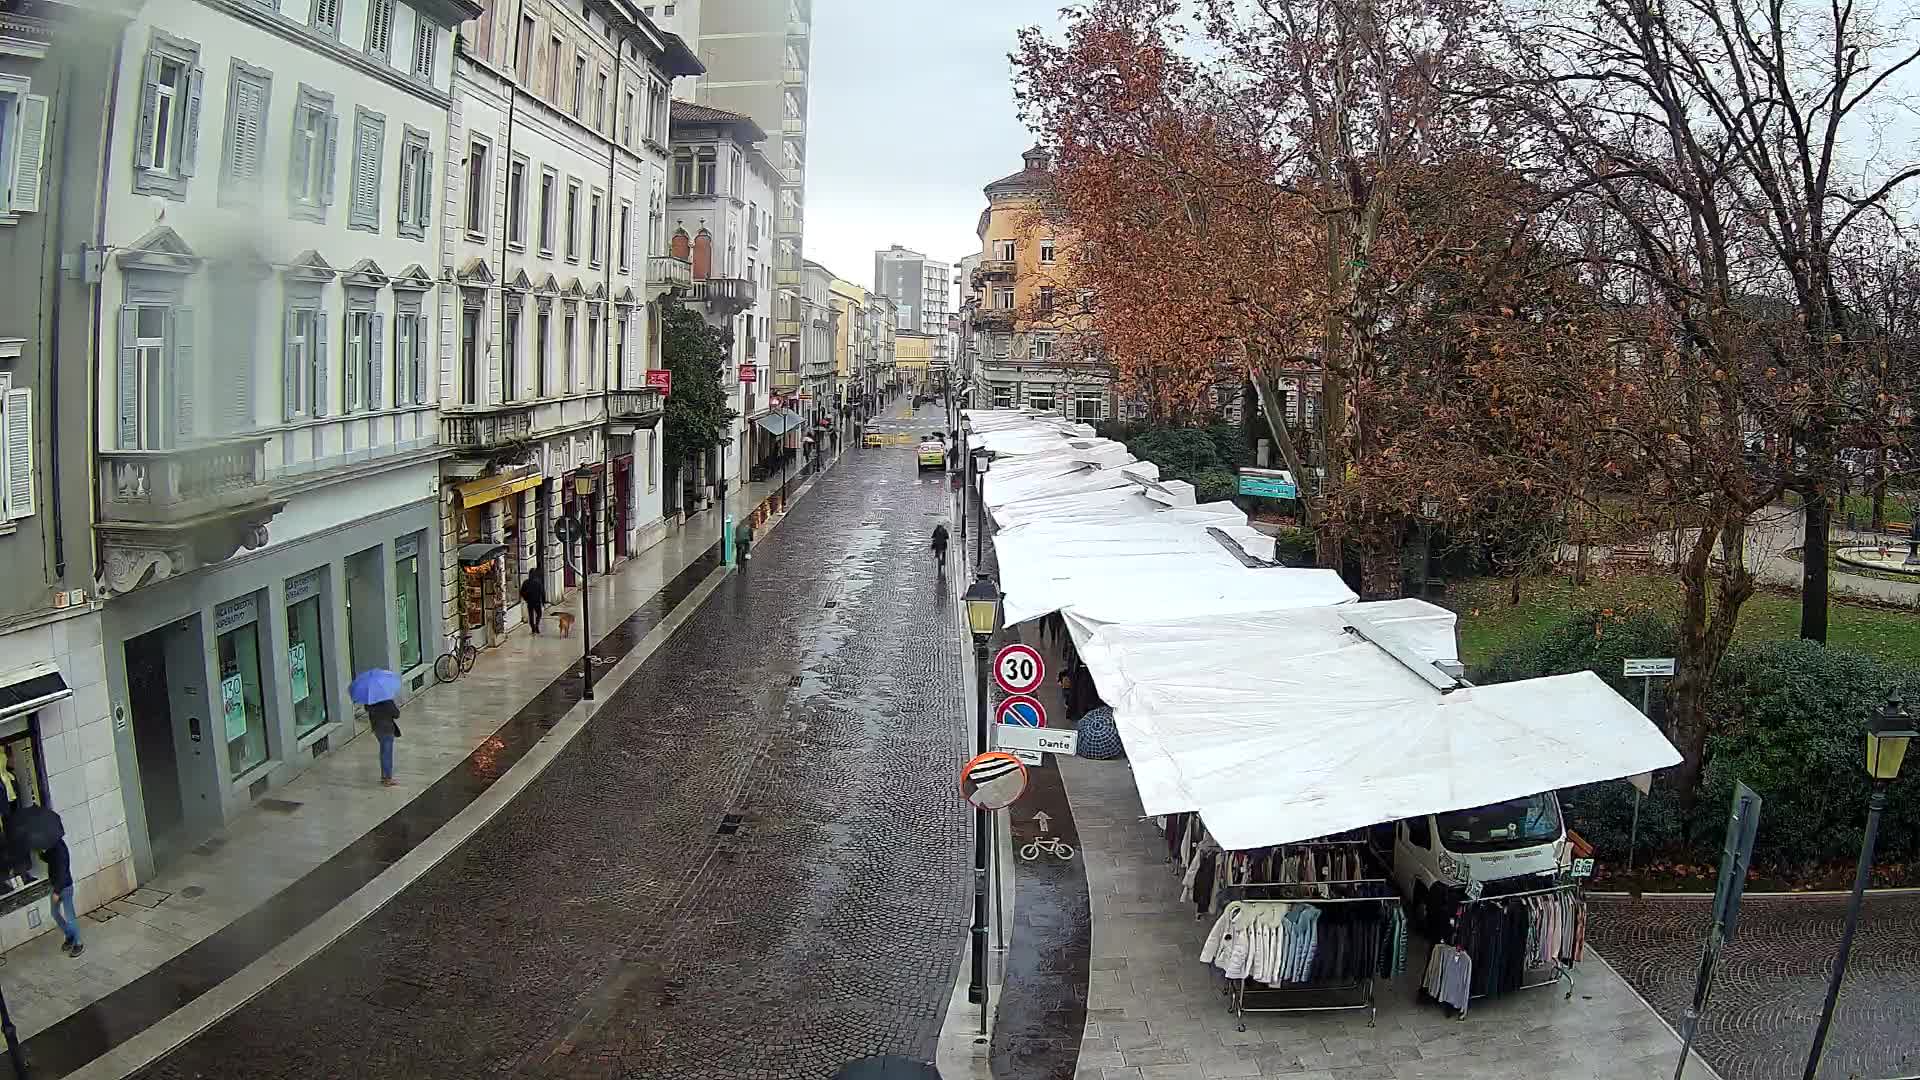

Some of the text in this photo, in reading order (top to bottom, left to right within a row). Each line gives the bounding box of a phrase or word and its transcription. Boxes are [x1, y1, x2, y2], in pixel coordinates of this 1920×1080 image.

[1006, 658, 1033, 680] 30
[223, 677, 242, 700] 130
[1038, 738, 1071, 750] Dante
